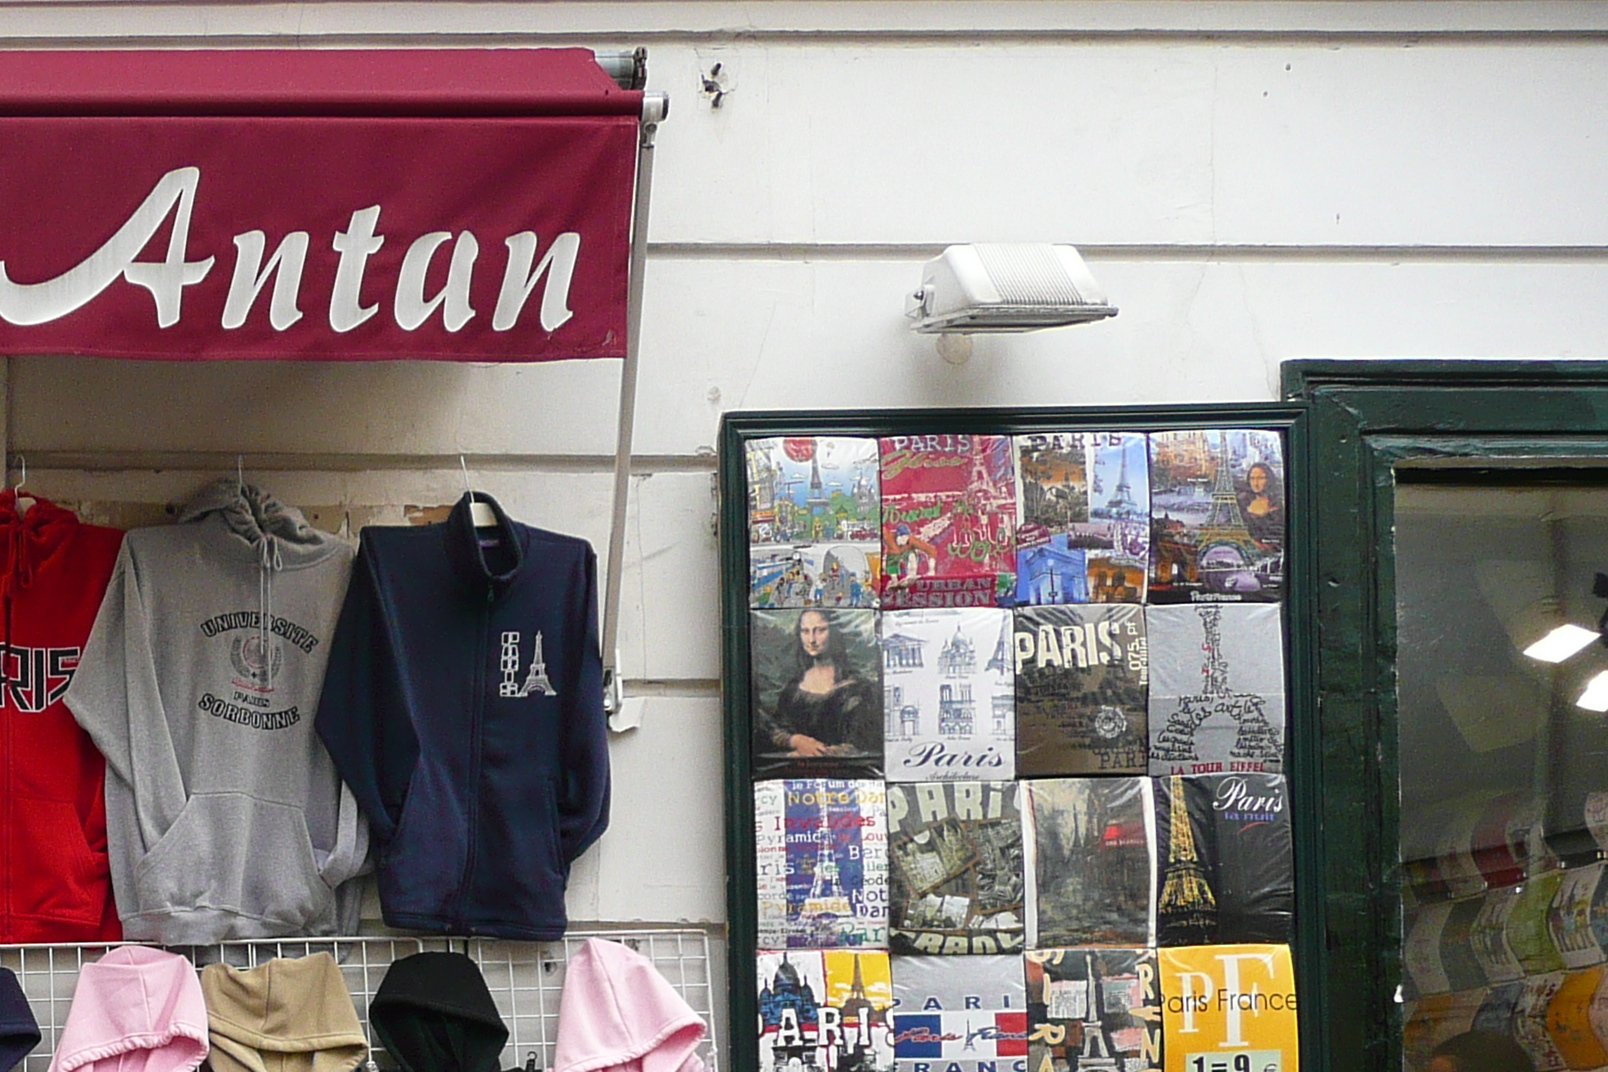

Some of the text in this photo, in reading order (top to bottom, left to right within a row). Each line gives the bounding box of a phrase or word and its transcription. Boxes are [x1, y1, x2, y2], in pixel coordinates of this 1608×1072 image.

[893, 435, 971, 454] PARIS
[916, 577, 992, 591] URBAN
[198, 610, 320, 656] UNIVERSITE
[1013, 621, 1123, 676] PARIS
[198, 692, 303, 730] SORBONNE
[903, 740, 1005, 769] Paris
[1170, 761, 1265, 776] LA TOUR EIFFEL
[788, 790, 851, 807] Notre
[1213, 776, 1284, 813] Paris
[1217, 988, 1298, 1012] France
